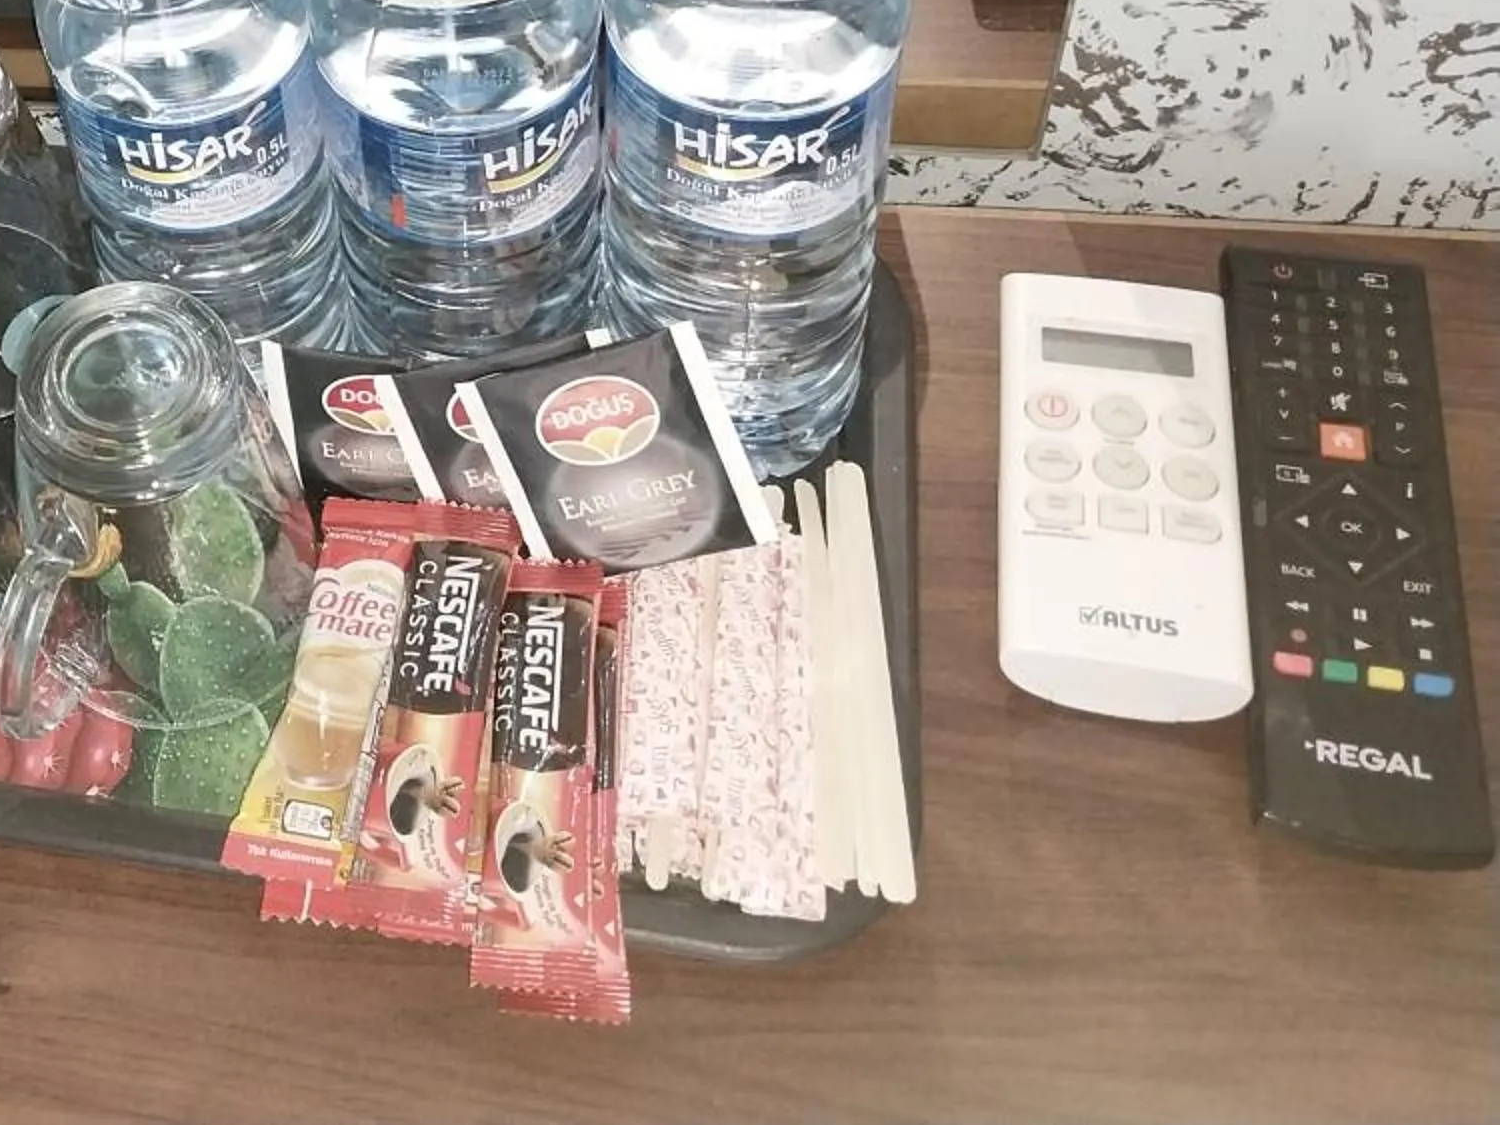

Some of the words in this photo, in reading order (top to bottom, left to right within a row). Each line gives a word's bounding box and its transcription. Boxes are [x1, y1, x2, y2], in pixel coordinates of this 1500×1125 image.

[1326, 296, 1338, 308] 2
[1383, 302, 1394, 315] 3
[1271, 313, 1282, 325] 4
[1385, 326, 1397, 338] 6
[1272, 334, 1283, 346] 7
[1331, 341, 1342, 354] 8
[551, 392, 636, 431] DOĞUŞ
[1340, 521, 1364, 535] OK
[1280, 562, 1317, 579] BACK
[1403, 579, 1434, 595] EXIT
[316, 611, 392, 641] mate
[399, 560, 439, 678] CLASSIC
[1103, 610, 1180, 637] ALTUS
[495, 611, 520, 733] CLASSIC
[1315, 737, 1434, 781] REGAL
